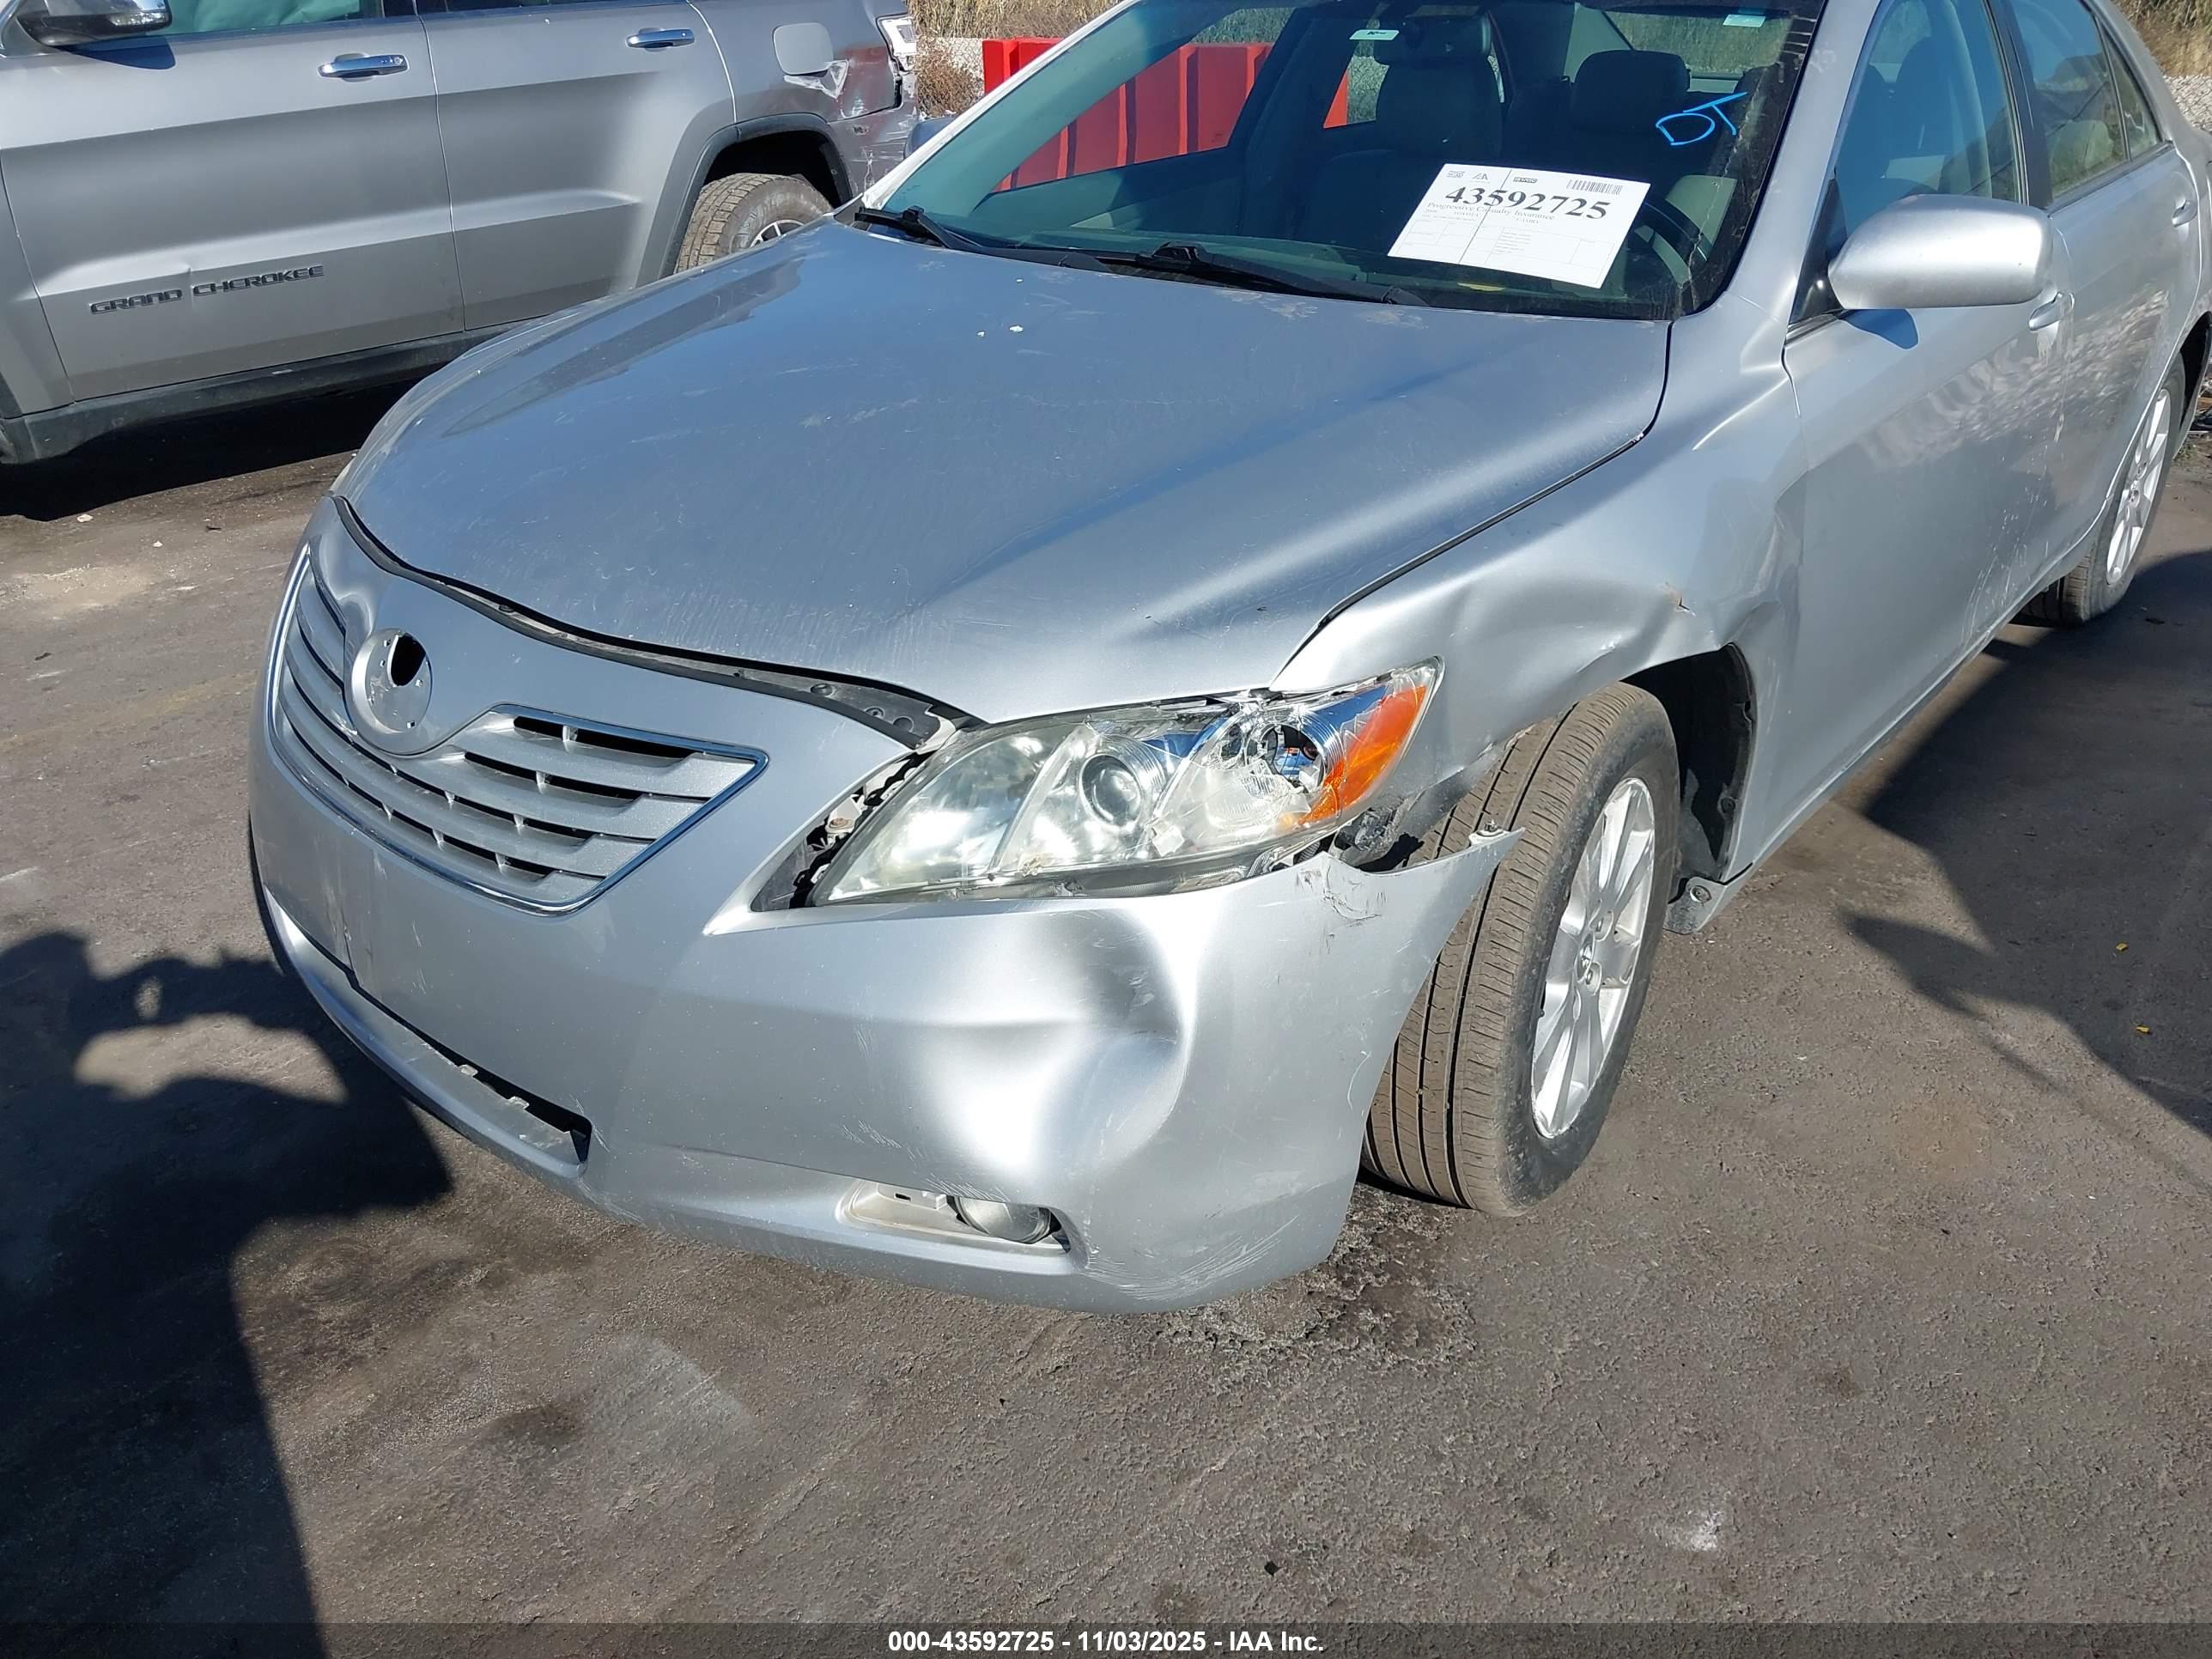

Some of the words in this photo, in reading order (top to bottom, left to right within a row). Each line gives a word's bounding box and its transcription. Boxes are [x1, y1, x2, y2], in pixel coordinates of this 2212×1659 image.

[1444, 186, 1612, 220] 43592725
[89, 289, 182, 314] GRAND
[191, 265, 324, 296] CHEROKEE
